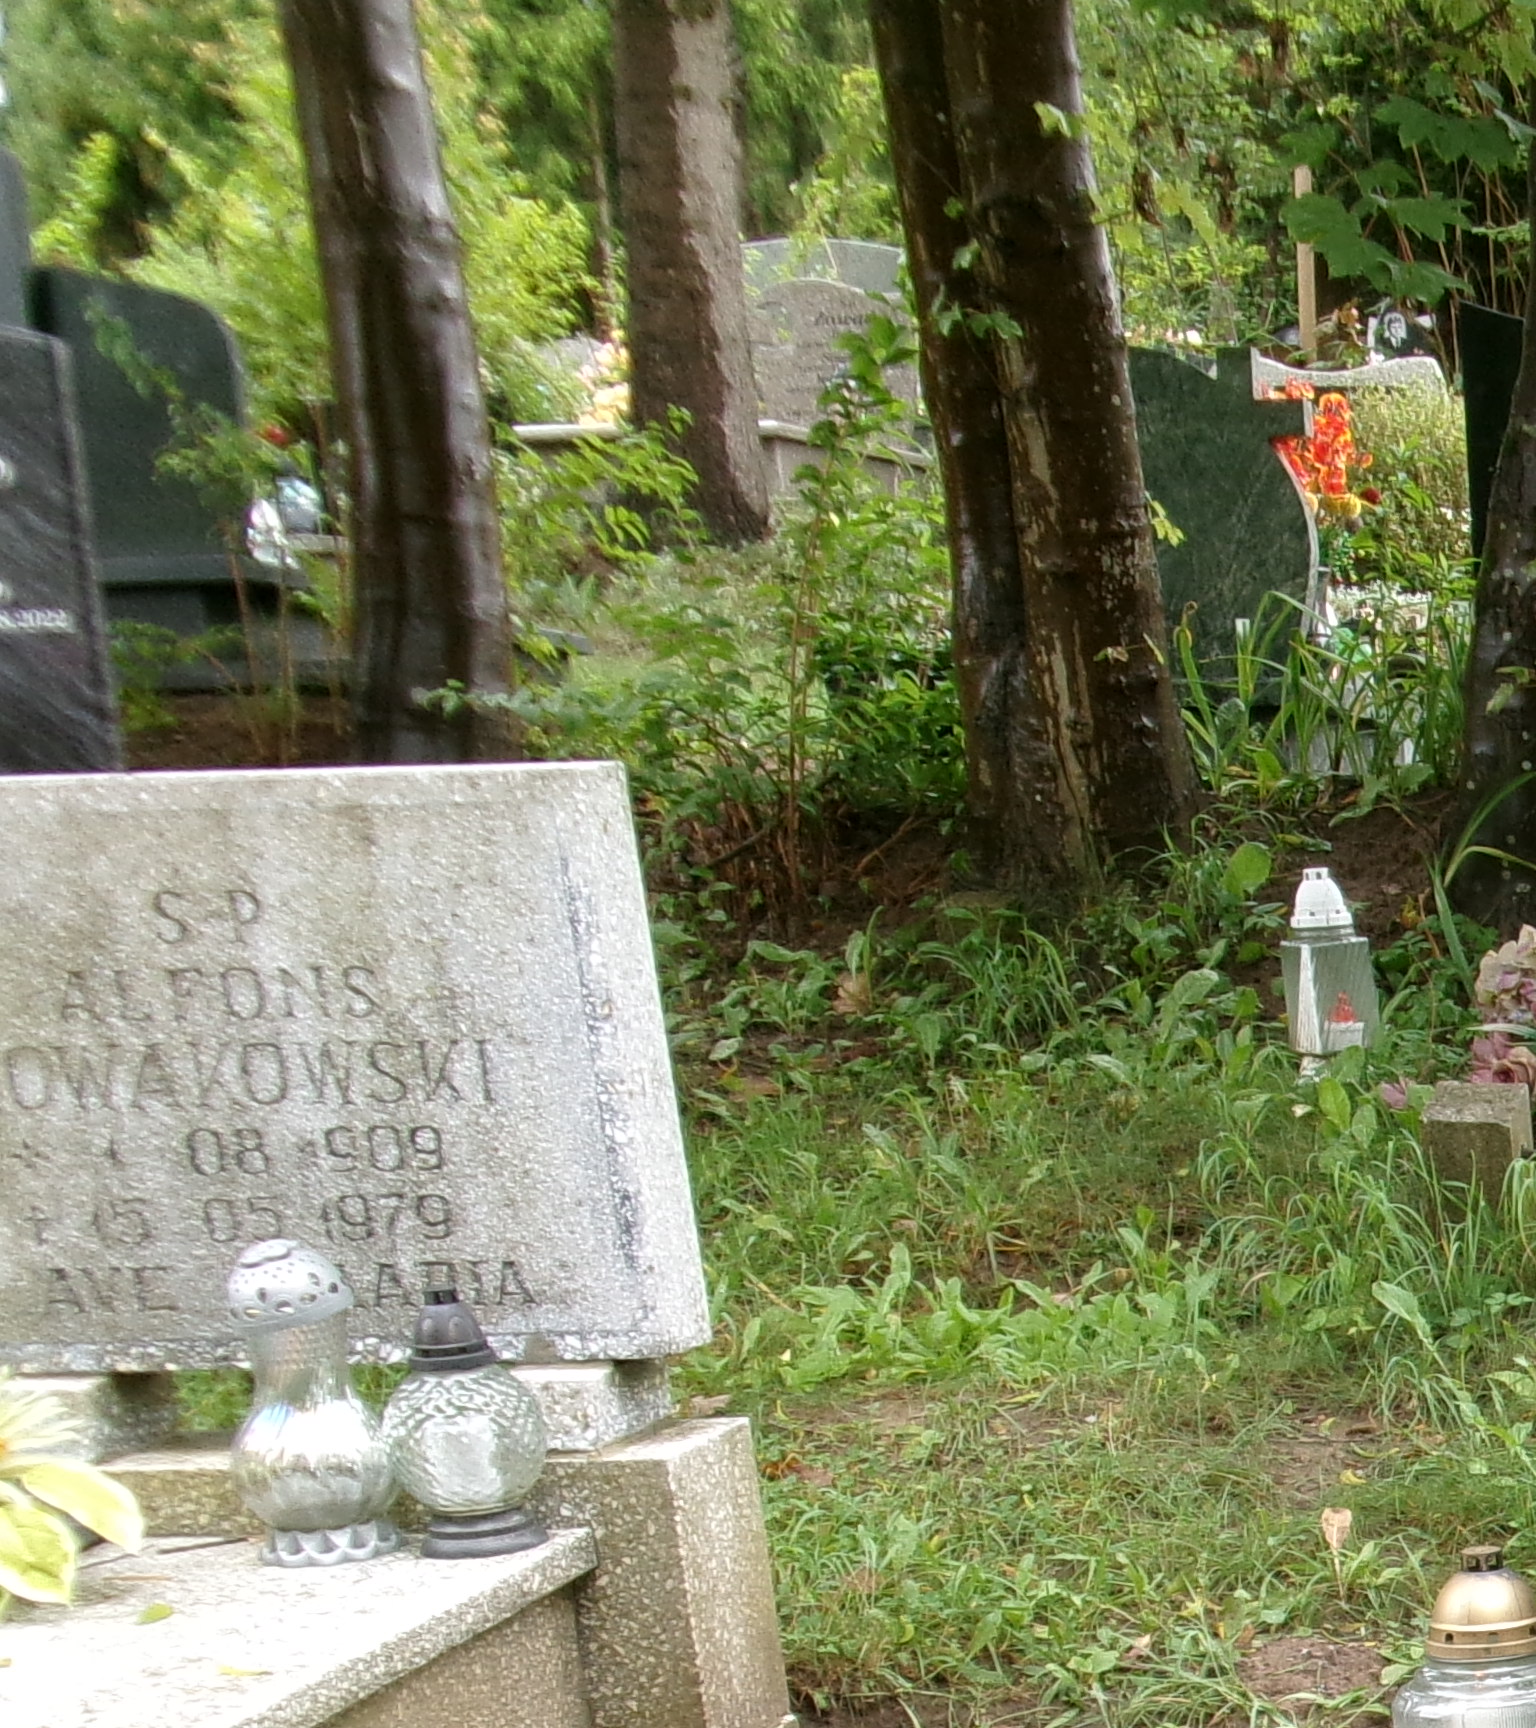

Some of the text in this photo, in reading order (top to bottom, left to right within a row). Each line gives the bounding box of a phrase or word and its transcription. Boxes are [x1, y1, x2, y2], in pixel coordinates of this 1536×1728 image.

[62, 966, 381, 1021] ALFONS
[6, 1039, 500, 1110] OWAKOWSKI
[204, 1197, 284, 1243] 05
